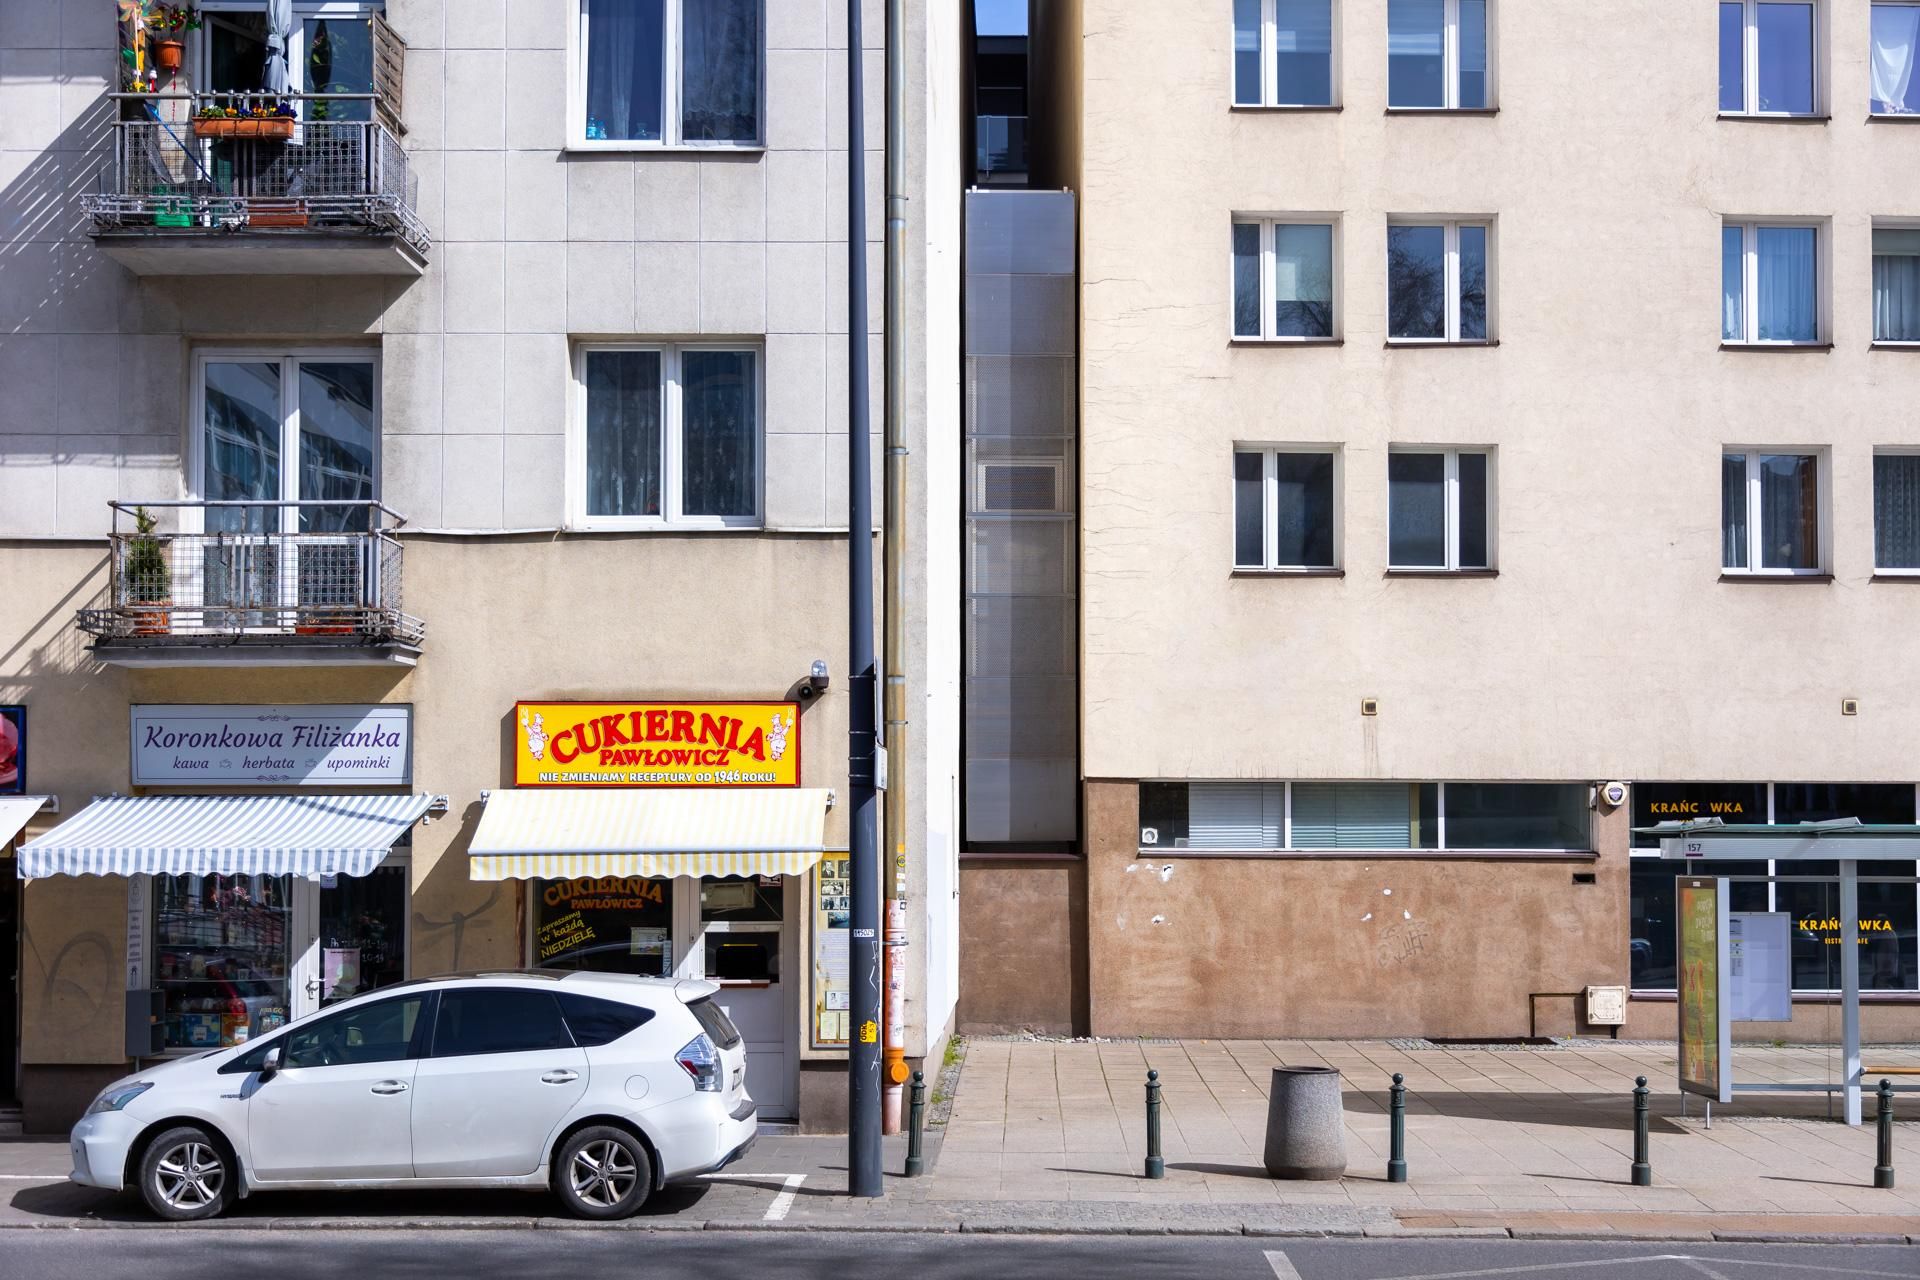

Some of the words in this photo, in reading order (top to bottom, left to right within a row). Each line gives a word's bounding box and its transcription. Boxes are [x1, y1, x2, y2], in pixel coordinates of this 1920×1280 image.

[144, 724, 283, 748] Koronkowa
[291, 724, 400, 748] Filiżanka
[550, 709, 766, 765] CUKIERNIA
[173, 756, 209, 769] kawa
[242, 756, 295, 769] herbata
[327, 756, 391, 772] upominki
[598, 749, 730, 767] PAWŁOWICZ
[539, 772, 559, 782] NIE
[561, 772, 626, 782] ZMIENIAMY
[629, 772, 692, 782] RECEPTURY
[695, 772, 712, 782] OD
[714, 769, 740, 784] 1946
[741, 772, 776, 783] ROKU!
[1688, 843, 1702, 852] 157
[543, 877, 663, 906] CUKIERNIA
[570, 898, 644, 909] PAWŁOWICZ
[536, 910, 581, 936] Zapraszamy
[541, 936, 551, 944] w
[554, 919, 585, 938] każdą
[541, 927, 597, 959] NIEDZIELĘ
